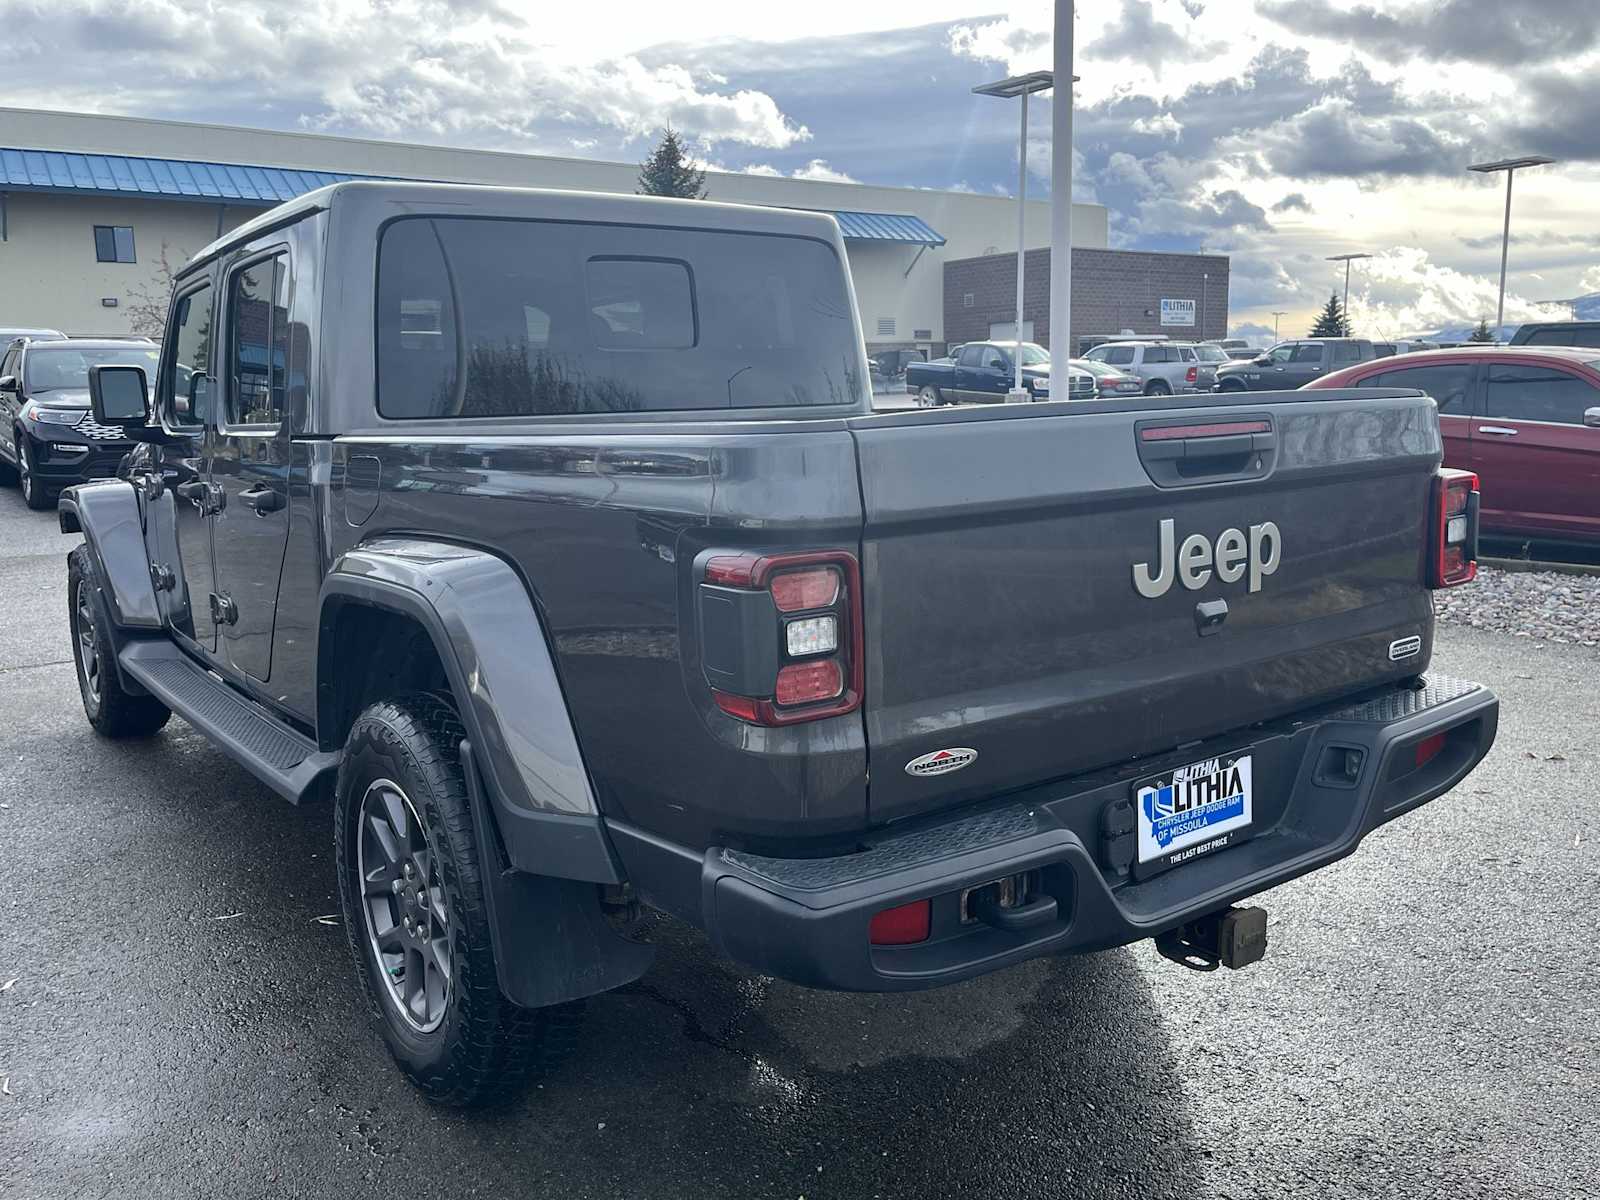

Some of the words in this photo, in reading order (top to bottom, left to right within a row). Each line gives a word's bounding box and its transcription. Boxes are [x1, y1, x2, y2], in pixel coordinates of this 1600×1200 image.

[1132, 518, 1282, 598] Jeep
[914, 754, 970, 771] NORTH
[1183, 759, 1221, 781] LITHIA
[1174, 766, 1244, 813] LITHIA
[1158, 812, 1190, 829] CHRYSLER
[1190, 807, 1206, 821] JEEP
[1206, 801, 1227, 815] DODGE
[1227, 796, 1240, 808] RAM
[1158, 829, 1169, 841] OF
[1170, 816, 1209, 838] MISSOULA
[1170, 853, 1182, 864] THE
[1182, 848, 1197, 860] LAST
[1197, 842, 1211, 855] BEST
[1211, 836, 1228, 850] PRICE
